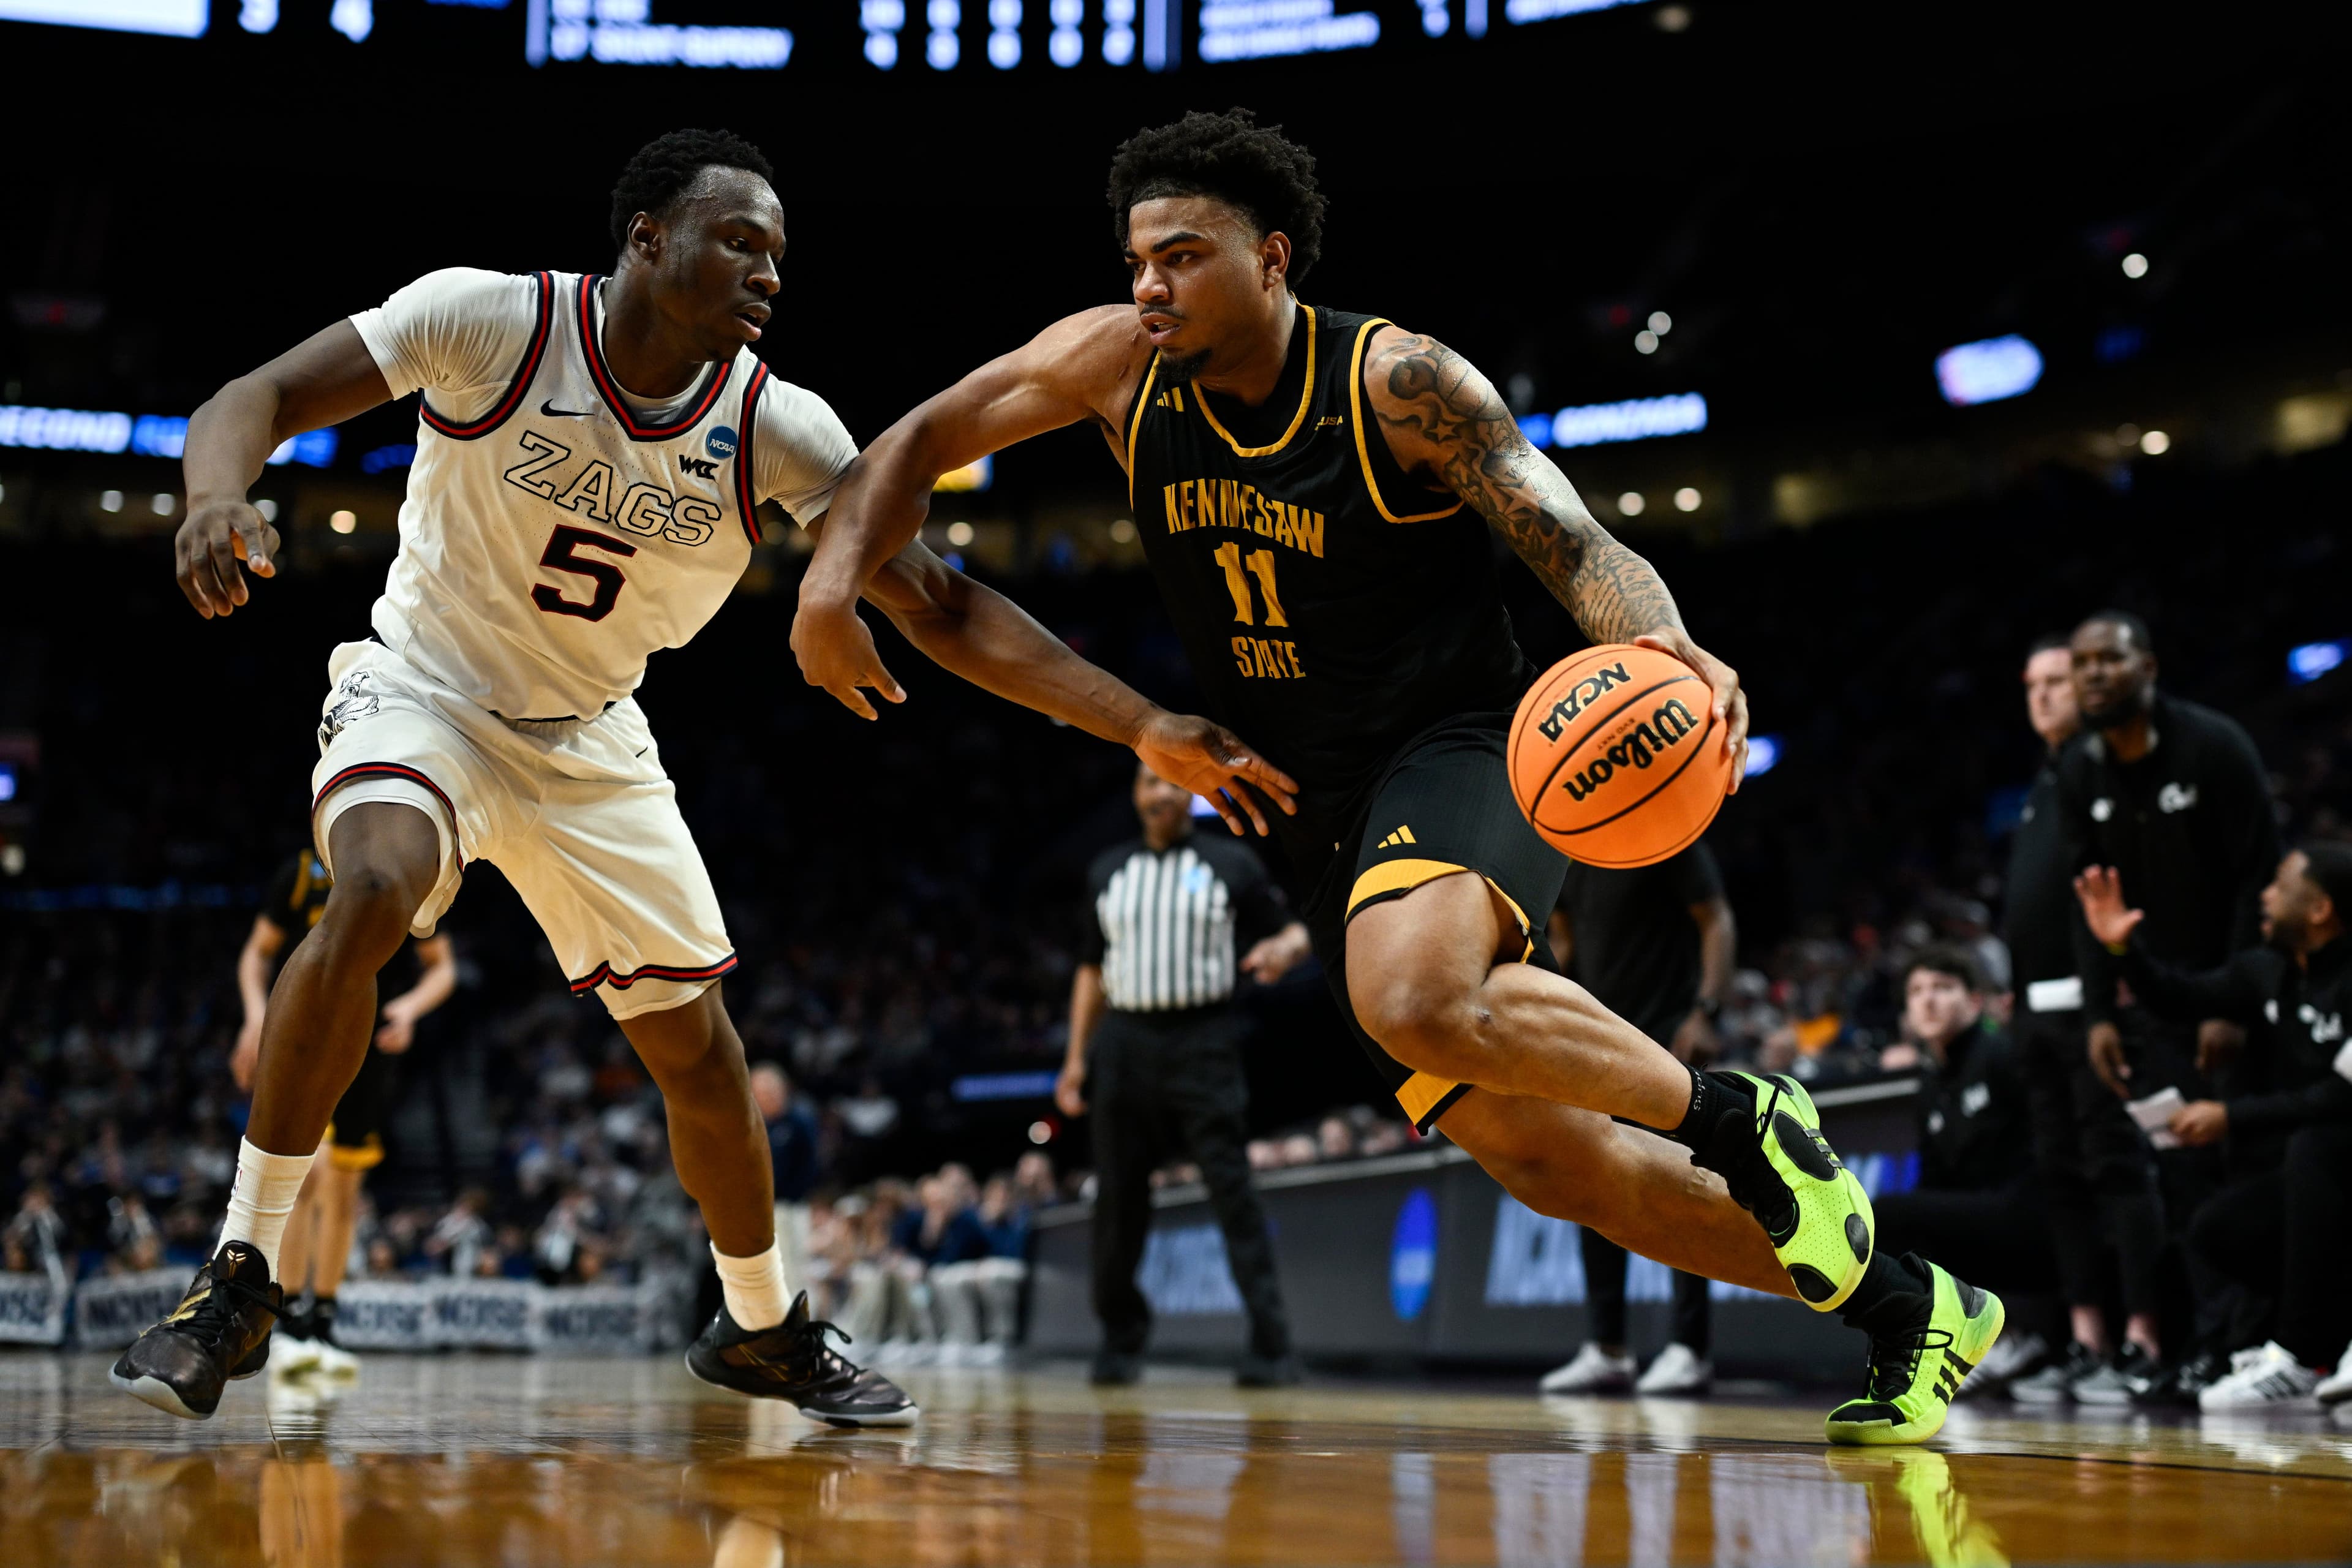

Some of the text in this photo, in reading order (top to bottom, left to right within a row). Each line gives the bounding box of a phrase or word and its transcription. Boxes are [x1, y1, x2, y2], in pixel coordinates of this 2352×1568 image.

[679, 454, 719, 481] WCC
[709, 438, 735, 454] NCAA
[504, 430, 722, 546] ZAGS
[1164, 478, 1324, 558] KENNESAW
[531, 524, 638, 622] 5
[1214, 541, 1289, 627] 11
[1231, 637, 1306, 679] STATE
[1537, 662, 1632, 743] NCAA
[1562, 698, 1699, 802] Wilson
